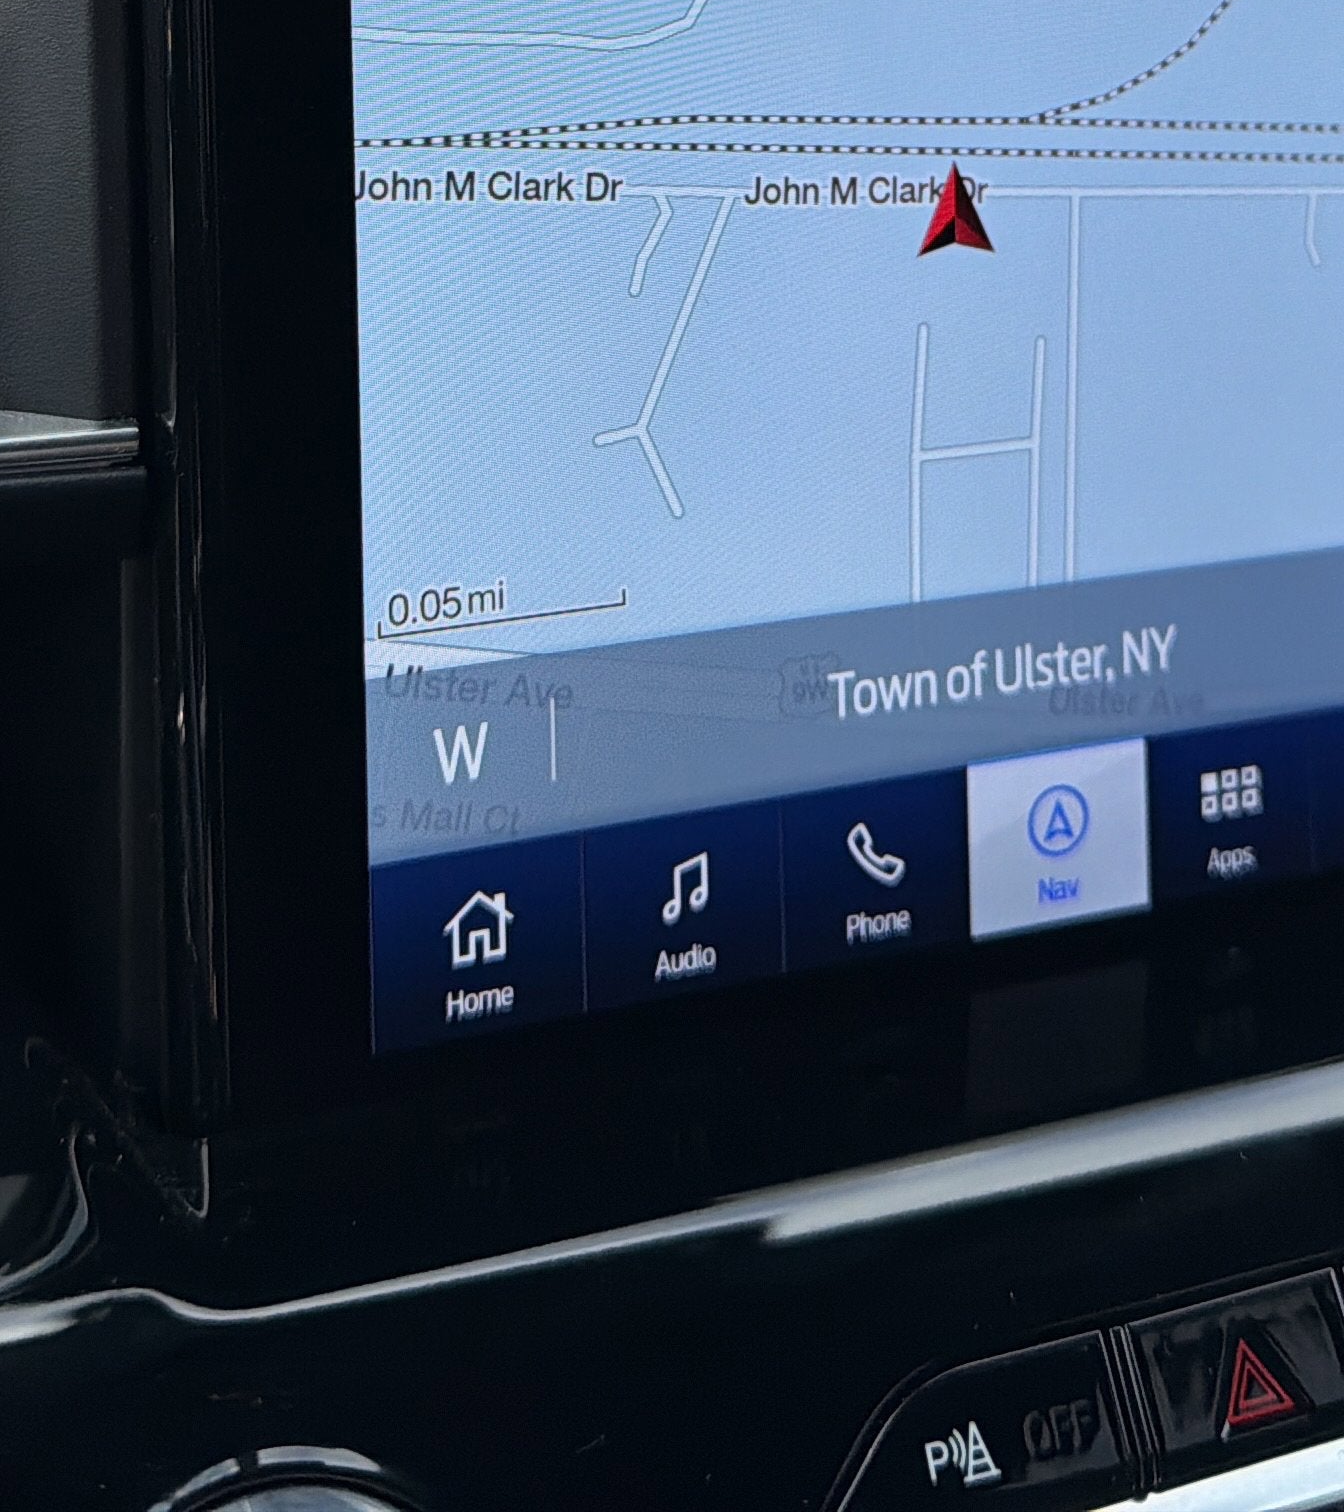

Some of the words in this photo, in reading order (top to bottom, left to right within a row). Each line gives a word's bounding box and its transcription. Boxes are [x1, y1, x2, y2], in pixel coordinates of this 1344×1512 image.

[354, 172, 433, 203] John
[444, 172, 475, 201] M
[488, 172, 574, 202] Clark
[584, 172, 624, 201] Dr
[744, 176, 819, 205] John
[830, 176, 859, 205] M
[868, 176, 944, 205] Clark
[387, 588, 462, 627] 0.05
[467, 580, 506, 614] mi
[828, 669, 940, 719] Town
[946, 650, 988, 704] of
[994, 639, 1116, 694] Ulster,
[1122, 624, 1180, 677] NY
[432, 721, 488, 784] W
[1208, 845, 1256, 876] Apps
[1037, 876, 1081, 904] Nav
[846, 907, 911, 940] Phone
[654, 944, 717, 978] Audio
[445, 985, 515, 1019] Home
[1024, 1397, 1094, 1458] OFF
